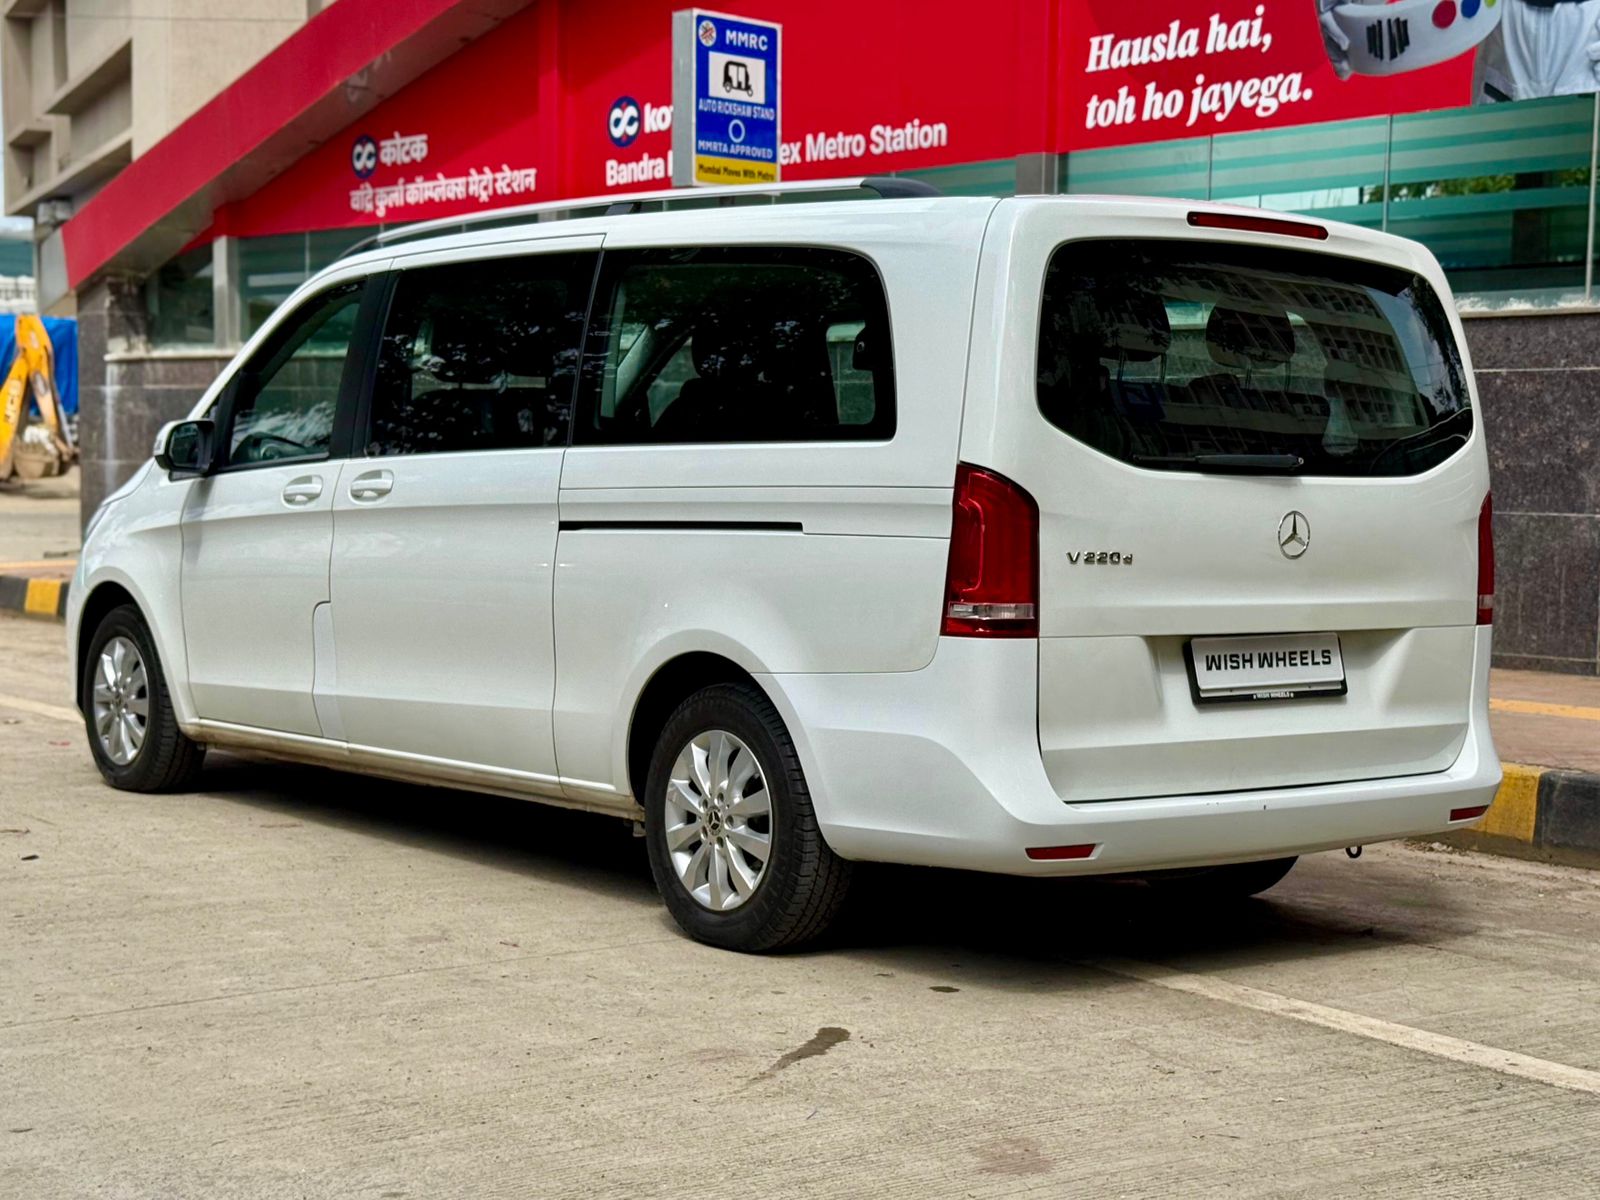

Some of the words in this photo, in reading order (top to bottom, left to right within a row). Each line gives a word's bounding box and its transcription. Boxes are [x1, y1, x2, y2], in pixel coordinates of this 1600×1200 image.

[725, 29, 769, 51] MMRC
[1085, 19, 1200, 73] Hausla
[1205, 4, 1272, 53] hai,
[698, 98, 717, 113] AUTO
[717, 100, 752, 118] RICKSHAW
[753, 106, 775, 121] STAND
[1085, 85, 1137, 129] toh
[1142, 81, 1184, 122] ho
[1186, 72, 1312, 127] jayega.
[380, 131, 428, 166] कोटक
[606, 152, 666, 187] Bandra
[805, 130, 866, 162] Metro
[869, 118, 948, 154] Station
[698, 140, 728, 154] MMRTA
[729, 144, 773, 159] APPROVED
[698, 163, 721, 175] Mumbai
[723, 166, 741, 177] Moves
[757, 171, 774, 181] Metro
[349, 181, 374, 214] वांद्रे
[375, 176, 405, 218] कुर्ला
[405, 172, 468, 206] कॉम्प्लेक्स
[467, 167, 494, 203] मेट्रो
[494, 163, 537, 195] स्टेशन
[1065, 551, 1080, 565] V
[1205, 652, 1254, 671] WISH
[1257, 648, 1332, 669] WHEELS
